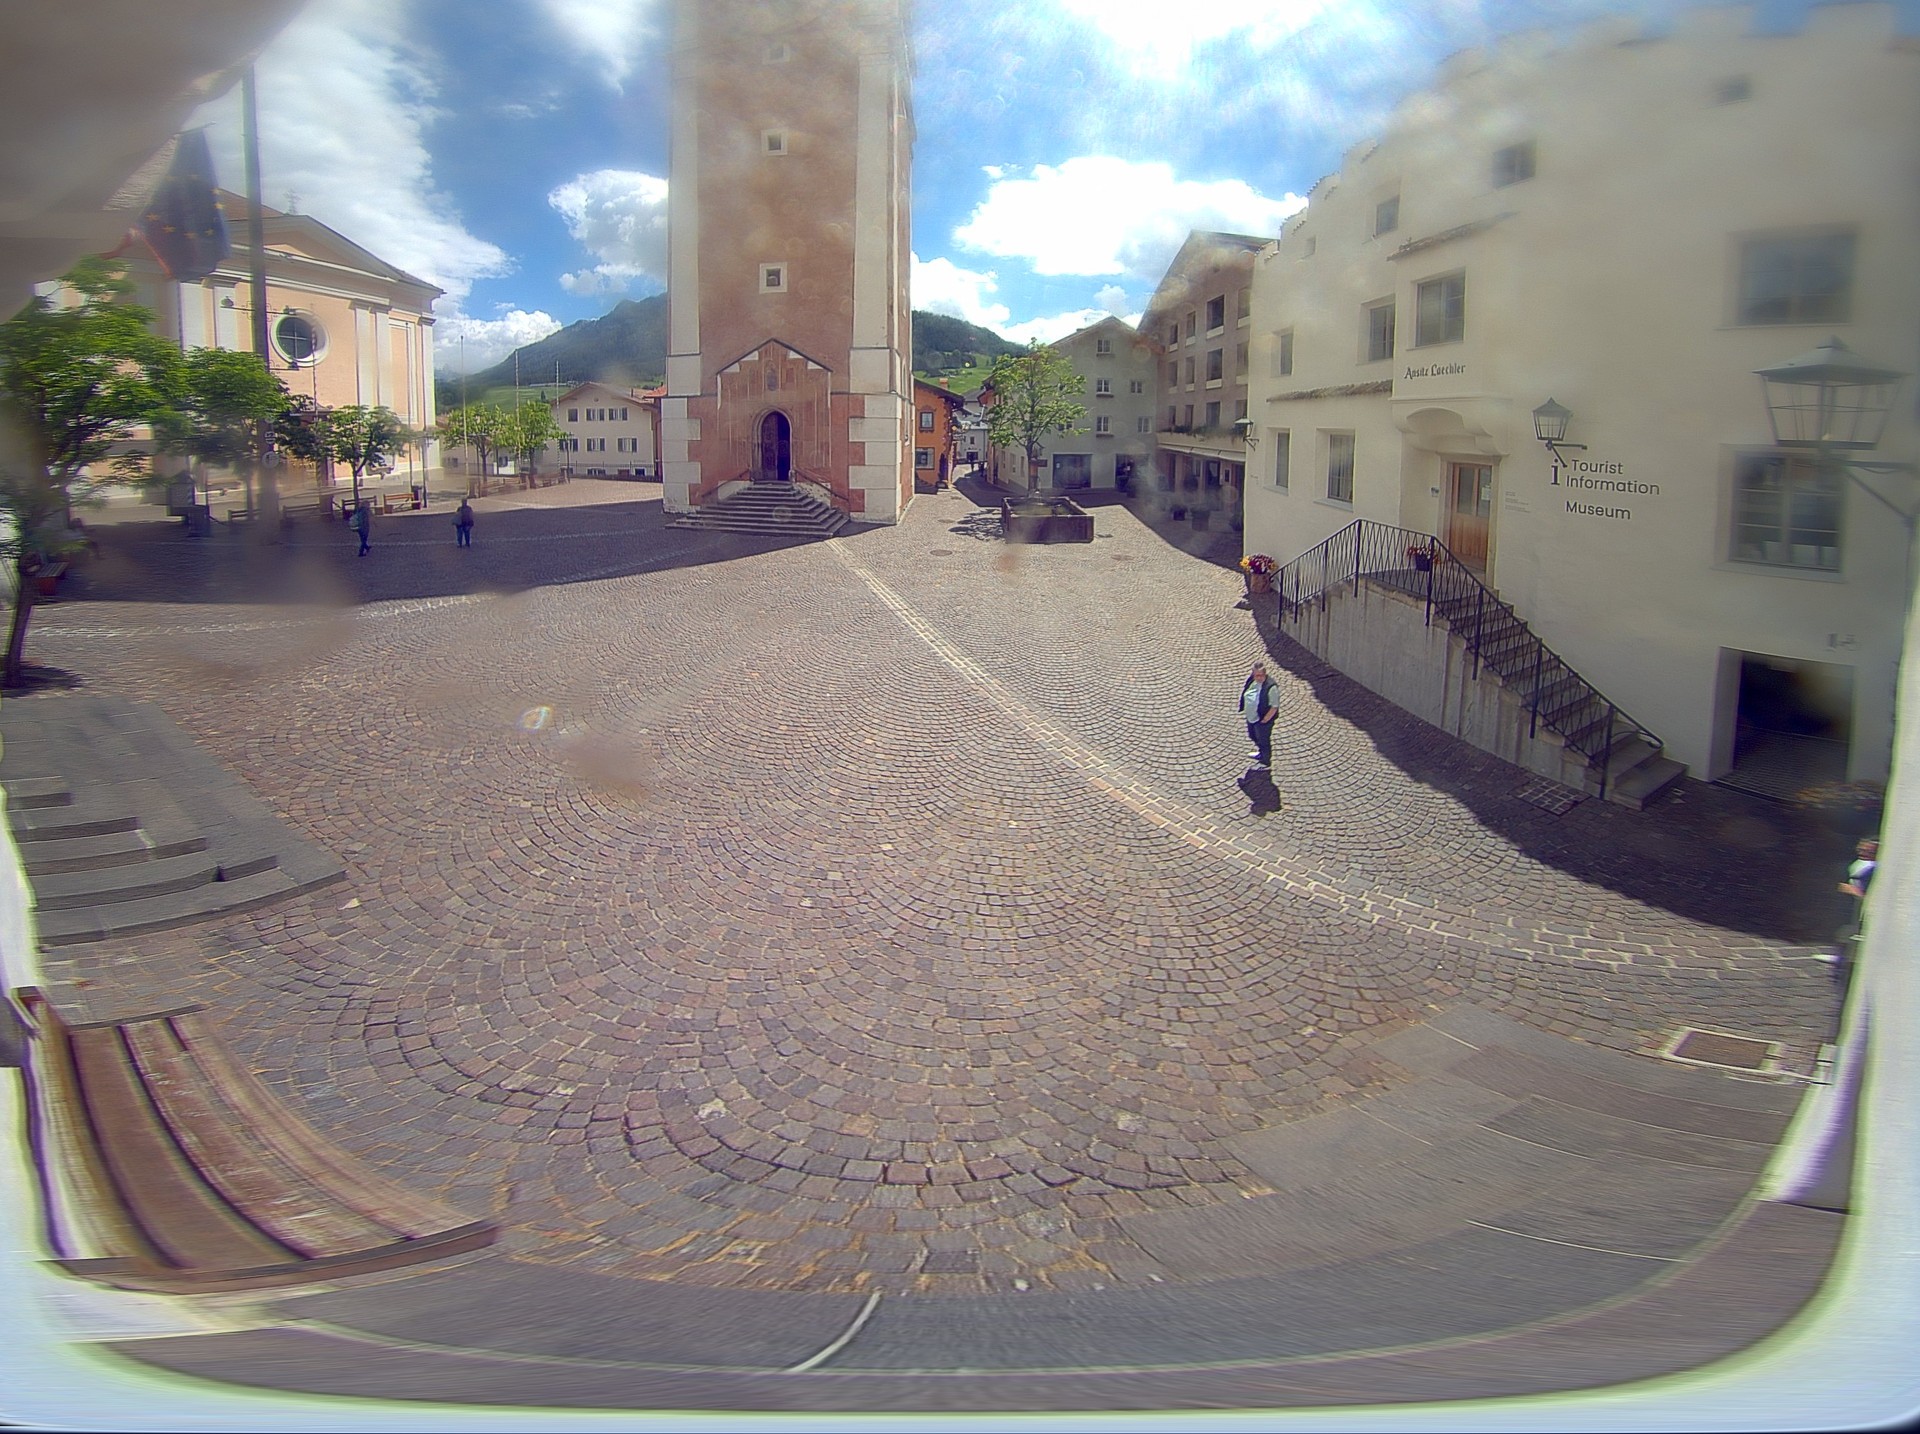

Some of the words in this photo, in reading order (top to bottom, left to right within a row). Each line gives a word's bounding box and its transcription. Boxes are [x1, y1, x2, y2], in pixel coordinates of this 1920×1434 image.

[1571, 459, 1624, 475] Tourist
[1566, 475, 1660, 495] Information
[1566, 501, 1631, 520] Museum
